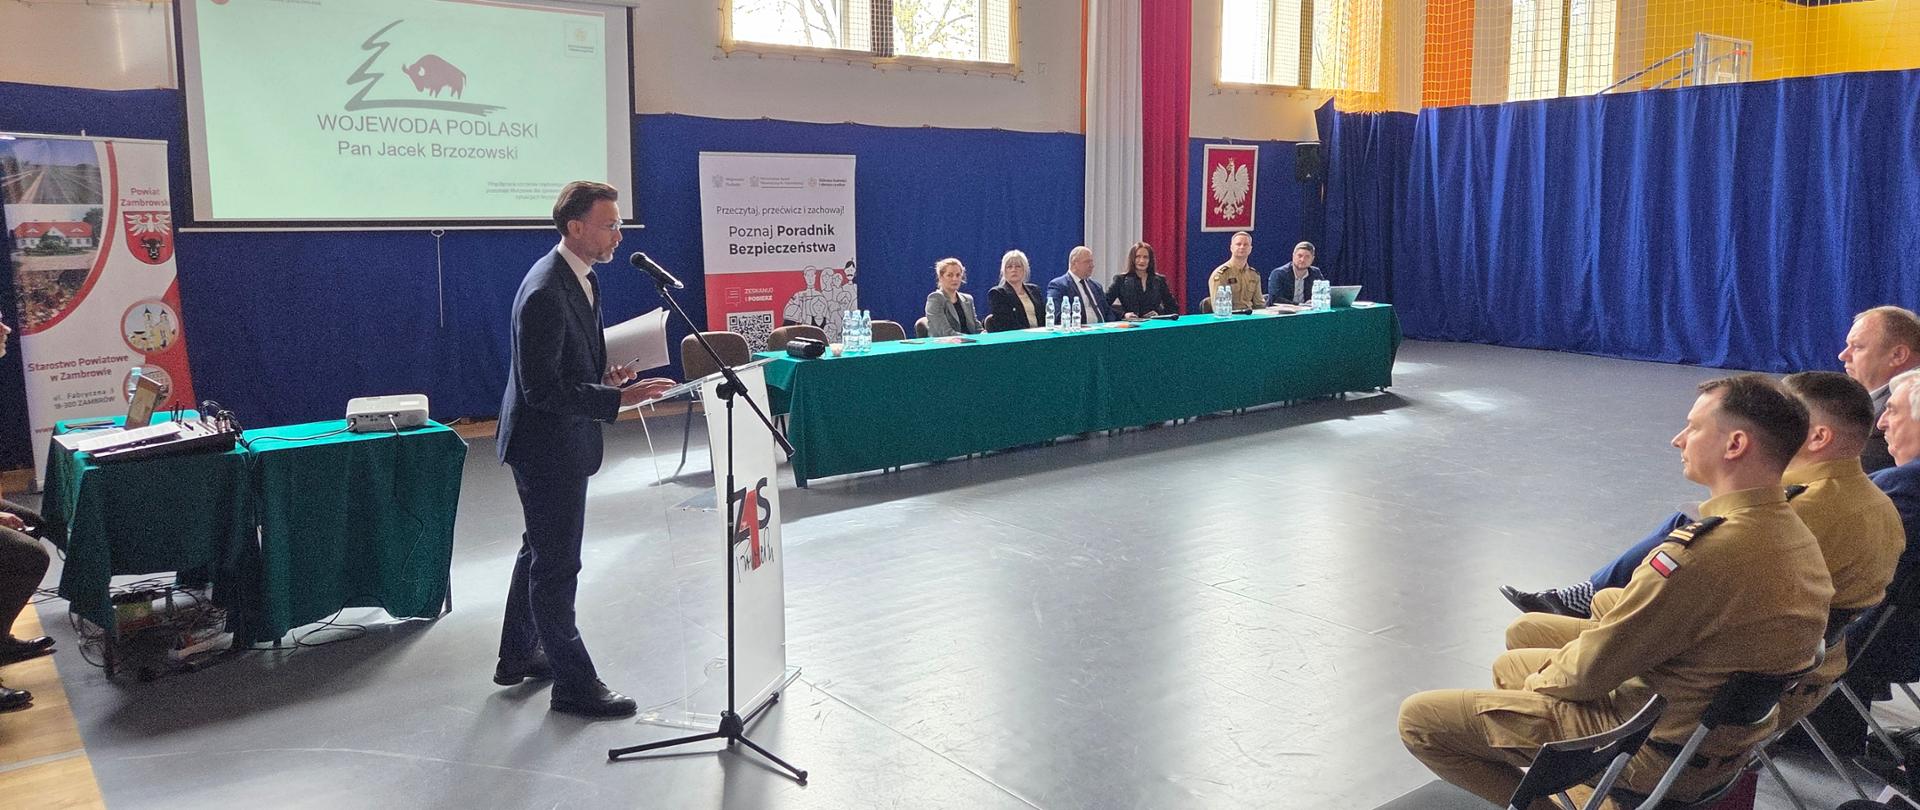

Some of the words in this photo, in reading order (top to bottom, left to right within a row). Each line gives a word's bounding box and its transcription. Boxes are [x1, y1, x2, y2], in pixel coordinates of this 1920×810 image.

[317, 113, 442, 135] WOJEWODA
[446, 119, 538, 138] PODLASKI
[338, 140, 372, 156] Pan
[377, 142, 426, 158] Jacek
[431, 143, 519, 160] Brzozowski
[130, 187, 160, 196] Powiat
[807, 205, 845, 216] zachowaj!
[729, 225, 774, 240] Poznaj
[777, 224, 835, 237] Poradnik
[729, 242, 836, 257] Bezpieczeństwa
[28, 361, 76, 372] Starostwo
[78, 355, 129, 366] Powiatowe
[50, 374, 59, 382] w
[60, 368, 112, 380] Zambrowie
